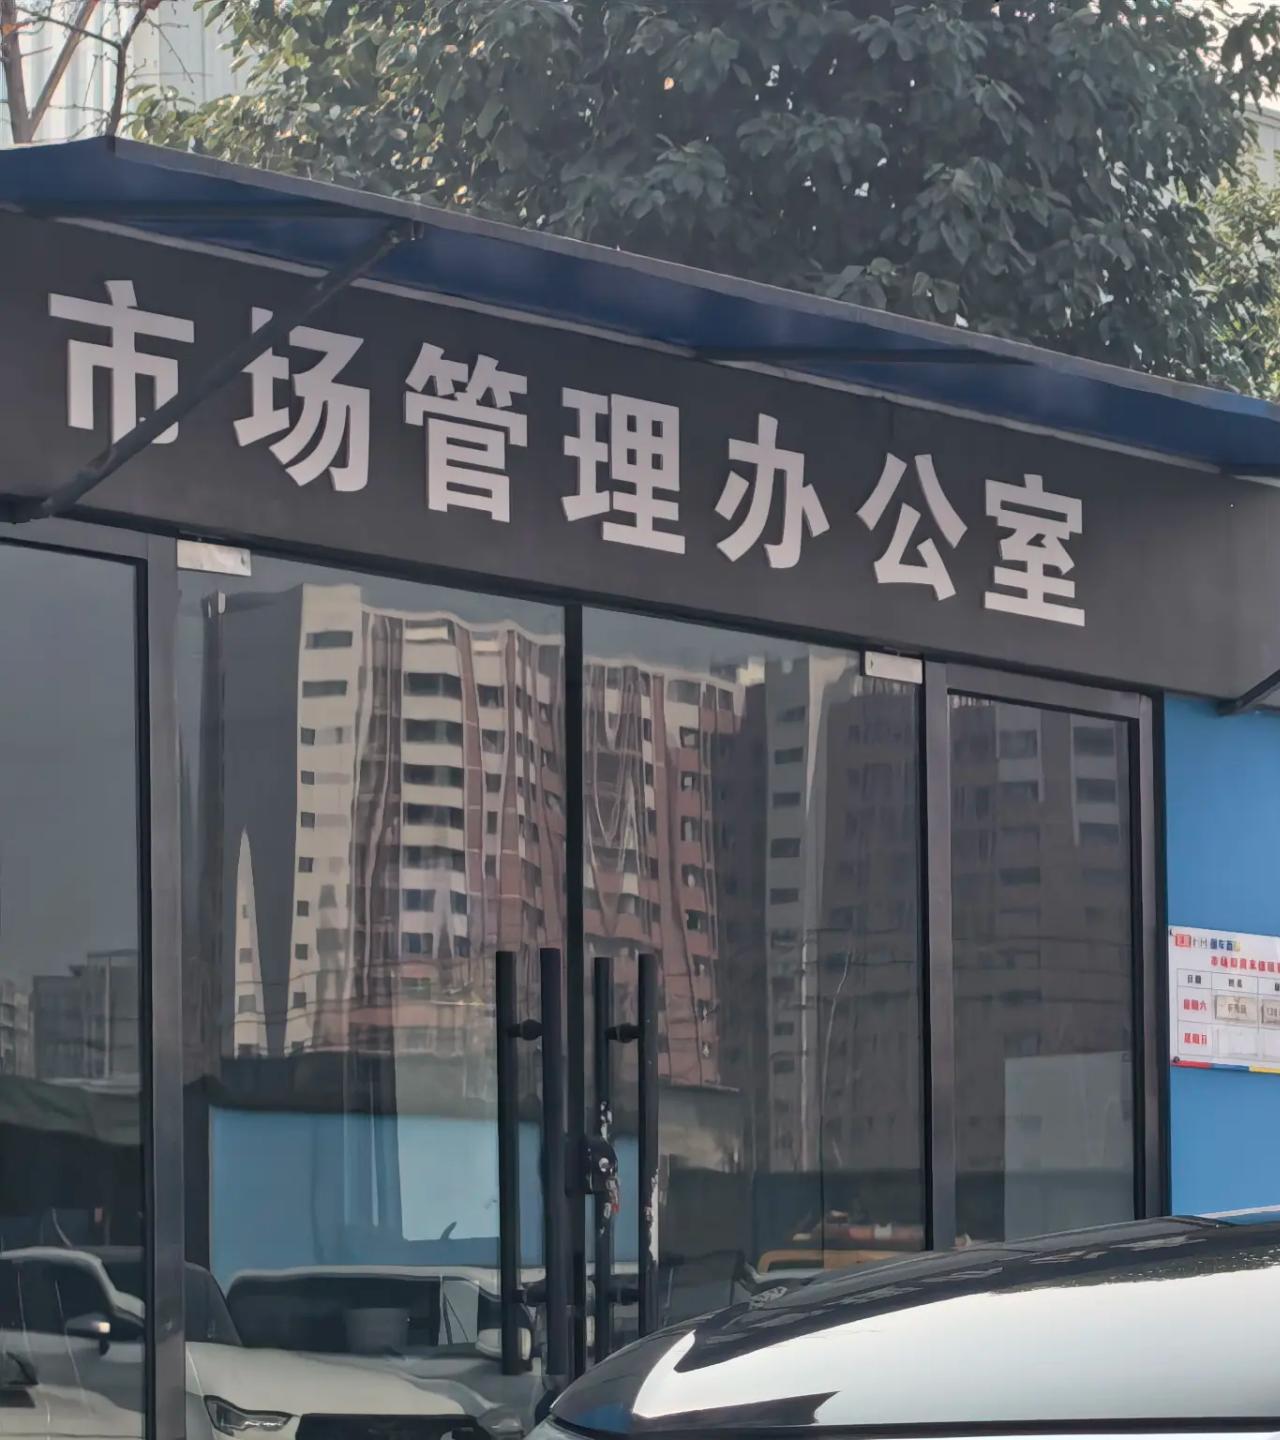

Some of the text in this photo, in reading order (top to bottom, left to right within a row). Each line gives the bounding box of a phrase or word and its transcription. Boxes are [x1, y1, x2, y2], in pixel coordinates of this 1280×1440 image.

[48, 279, 1086, 627] 市场管理办公室
